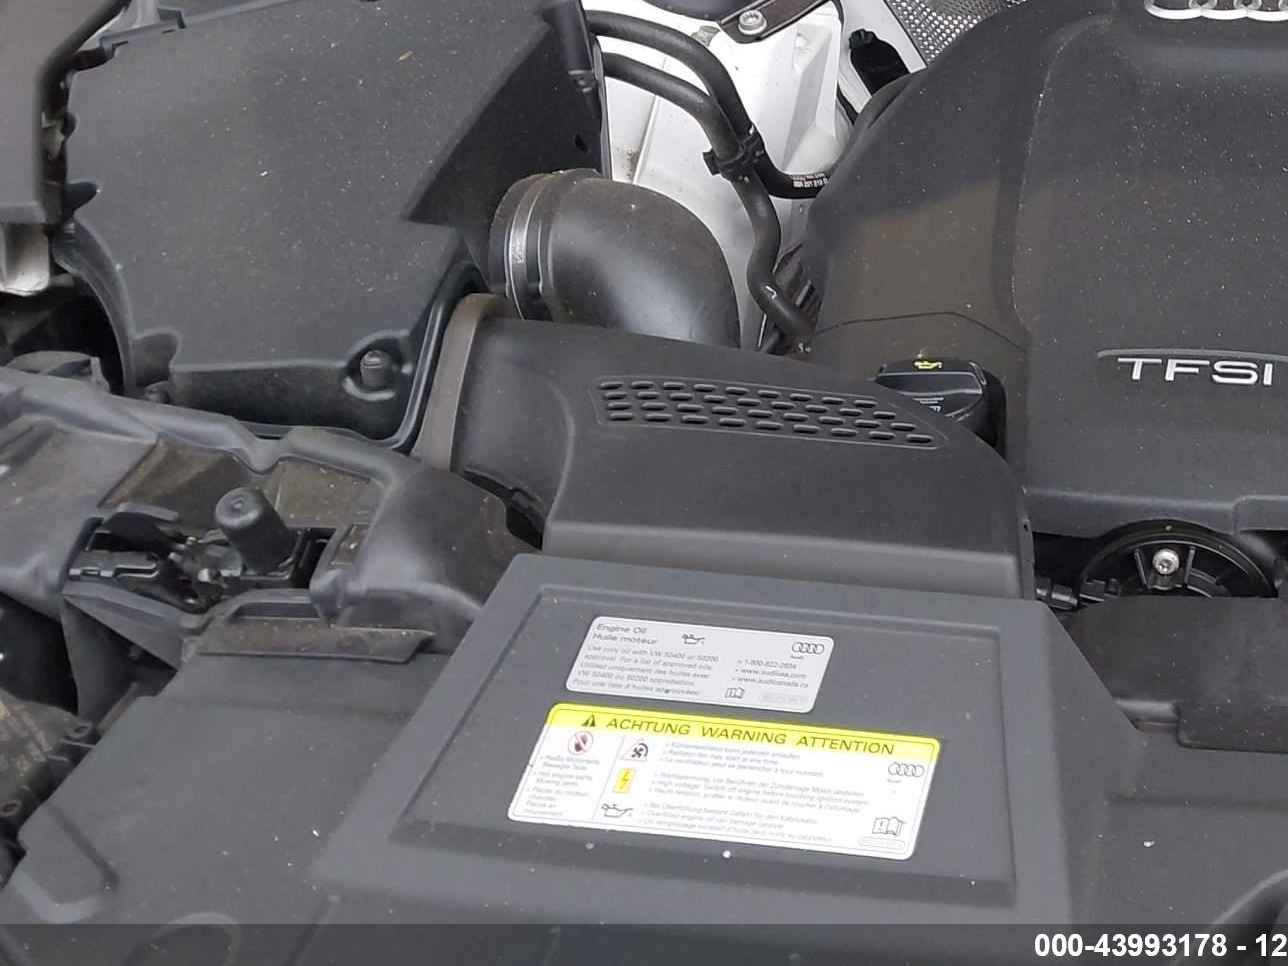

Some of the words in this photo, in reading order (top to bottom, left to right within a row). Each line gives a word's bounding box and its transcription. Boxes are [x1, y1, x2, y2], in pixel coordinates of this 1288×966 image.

[1117, 357, 1273, 387] TFSI
[592, 633, 618, 642] Huile
[620, 636, 658, 645] moteur
[596, 623, 631, 633] Engine
[633, 626, 648, 634] Oil
[606, 717, 691, 736] ACHTUNG
[701, 726, 787, 745] WARNING
[796, 735, 895, 755] ATTENTION
